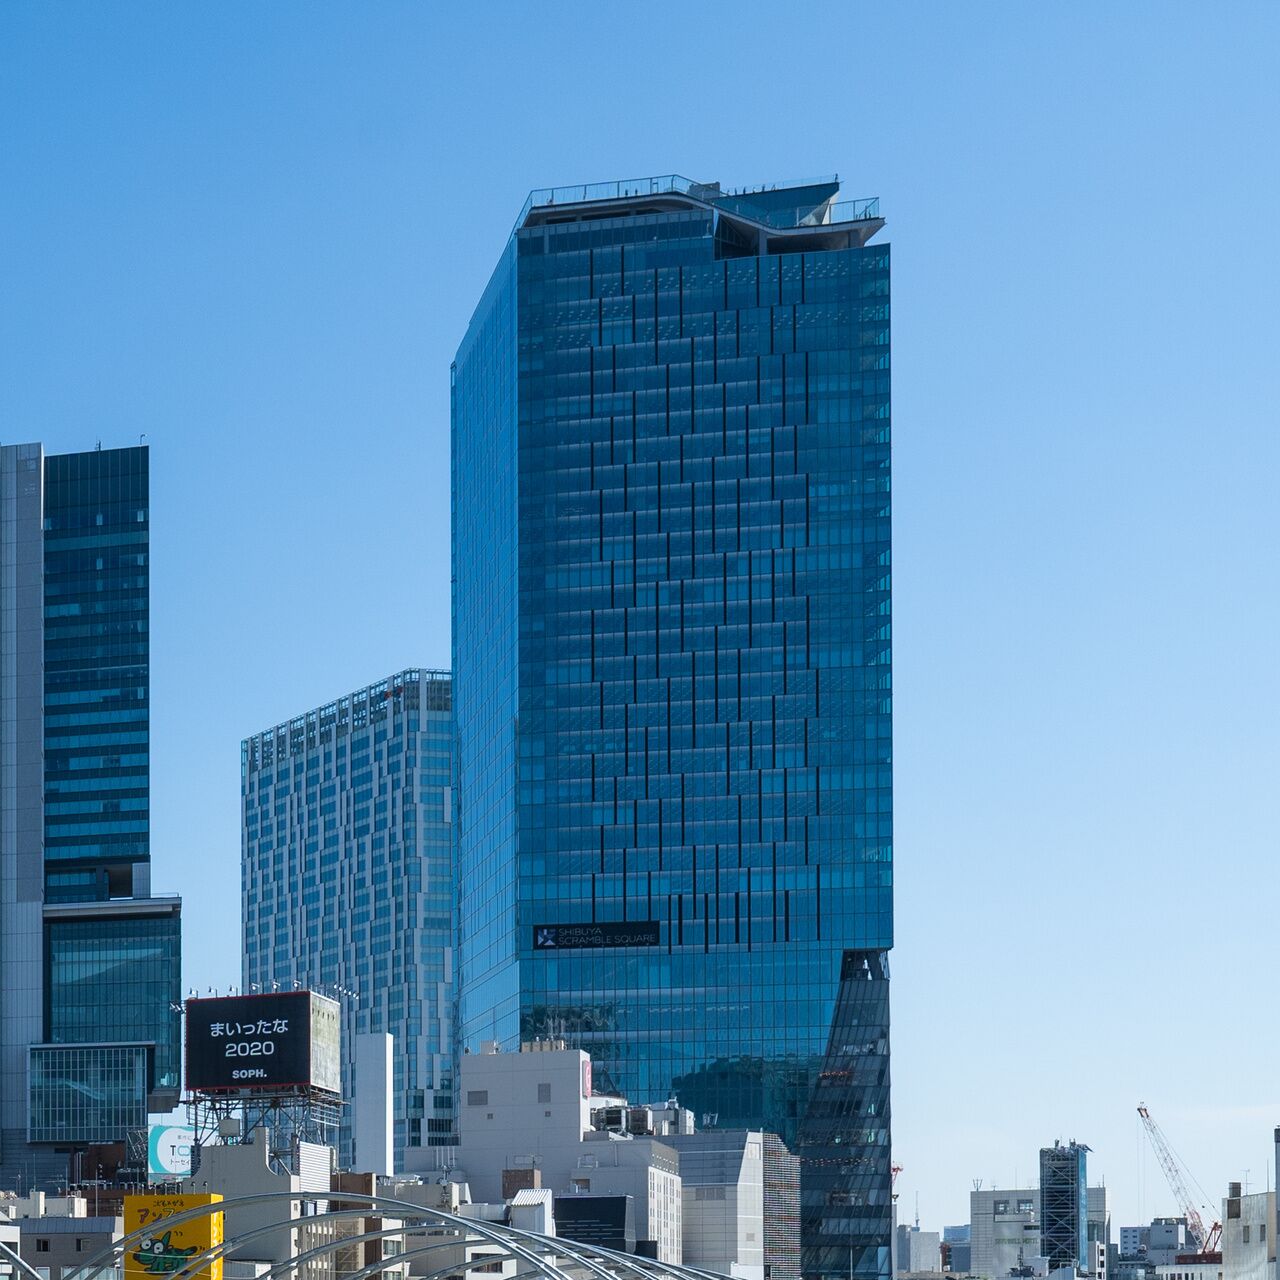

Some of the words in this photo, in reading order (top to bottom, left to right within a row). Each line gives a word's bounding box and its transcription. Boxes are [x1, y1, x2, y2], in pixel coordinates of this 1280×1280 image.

[558, 927, 602, 937] SHIBUYA
[558, 935, 612, 946] SCRAMBLE
[614, 933, 656, 944] SQUARE
[210, 1018, 289, 1037] まいったな
[225, 1041, 275, 1057] 2020
[232, 1068, 268, 1079] SOPH.
